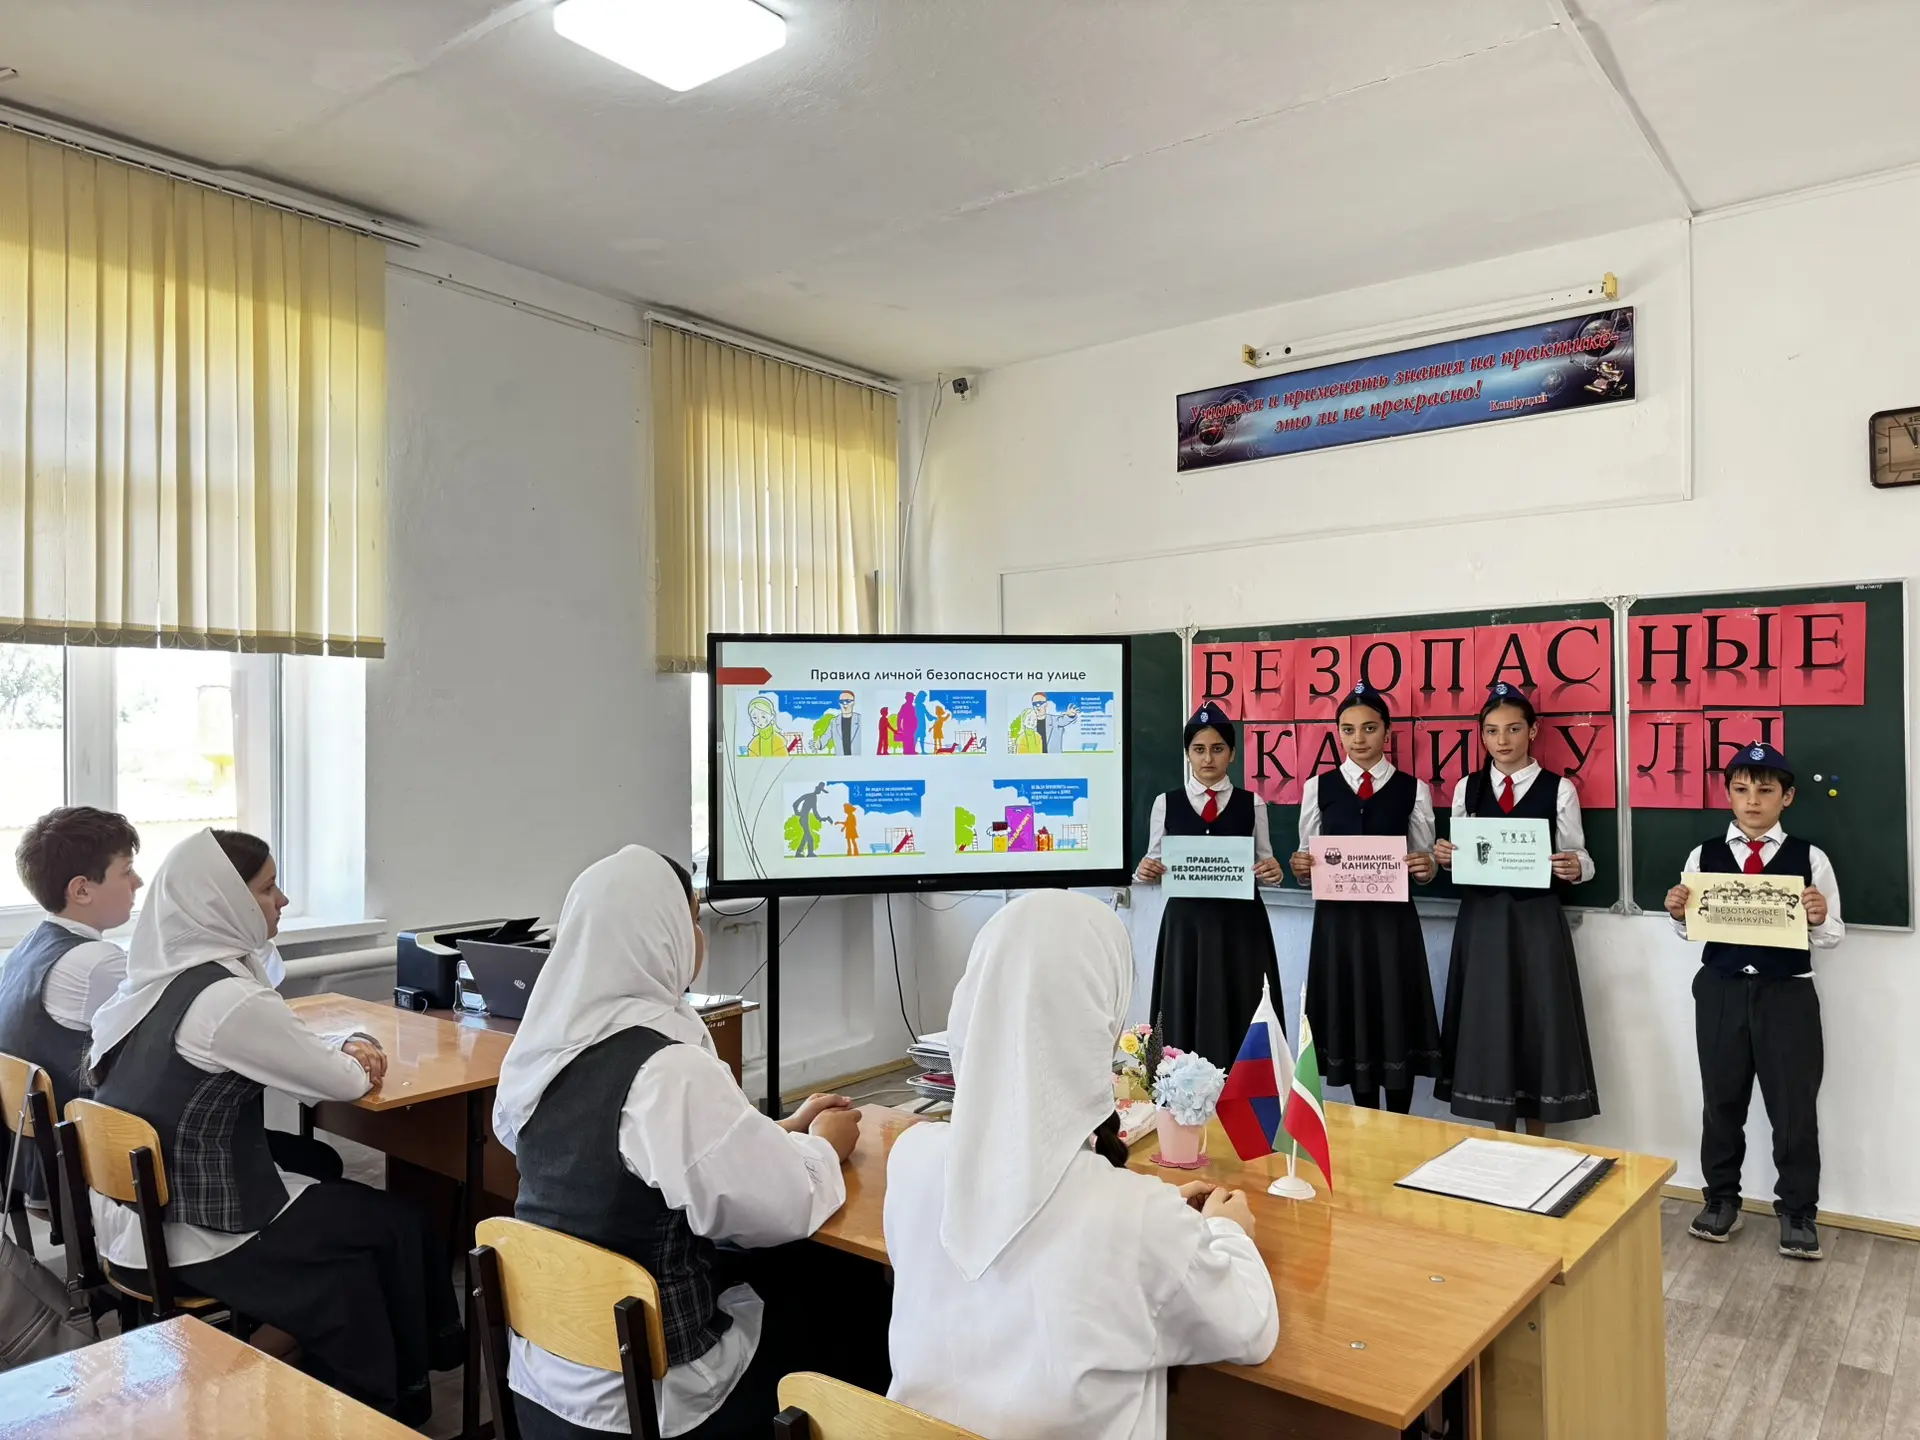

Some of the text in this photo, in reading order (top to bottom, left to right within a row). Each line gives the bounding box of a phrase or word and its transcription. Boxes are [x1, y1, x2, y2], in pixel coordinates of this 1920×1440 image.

[1268, 397, 1279, 409] и
[1283, 373, 1389, 411] применять
[1393, 358, 1465, 386] знания
[1469, 352, 1496, 373] на
[1273, 379, 1483, 433] это ли не прекрасно!
[1489, 391, 1549, 412] Конфуций
[810, 668, 1087, 682] Правила личной безопасности на улице
[1186, 856, 1230, 864] ПРАВИЛА
[1171, 865, 1245, 873] БЕЗОПАСНОСТИ
[1341, 861, 1401, 870] КАНИКУЛЫ!
[1188, 874, 1243, 882] КАНИКУЛАХ
[1715, 906, 1779, 917] БЕЗОПАСНЫЕ
[1721, 916, 1774, 925] КАНИКУЛЫ
